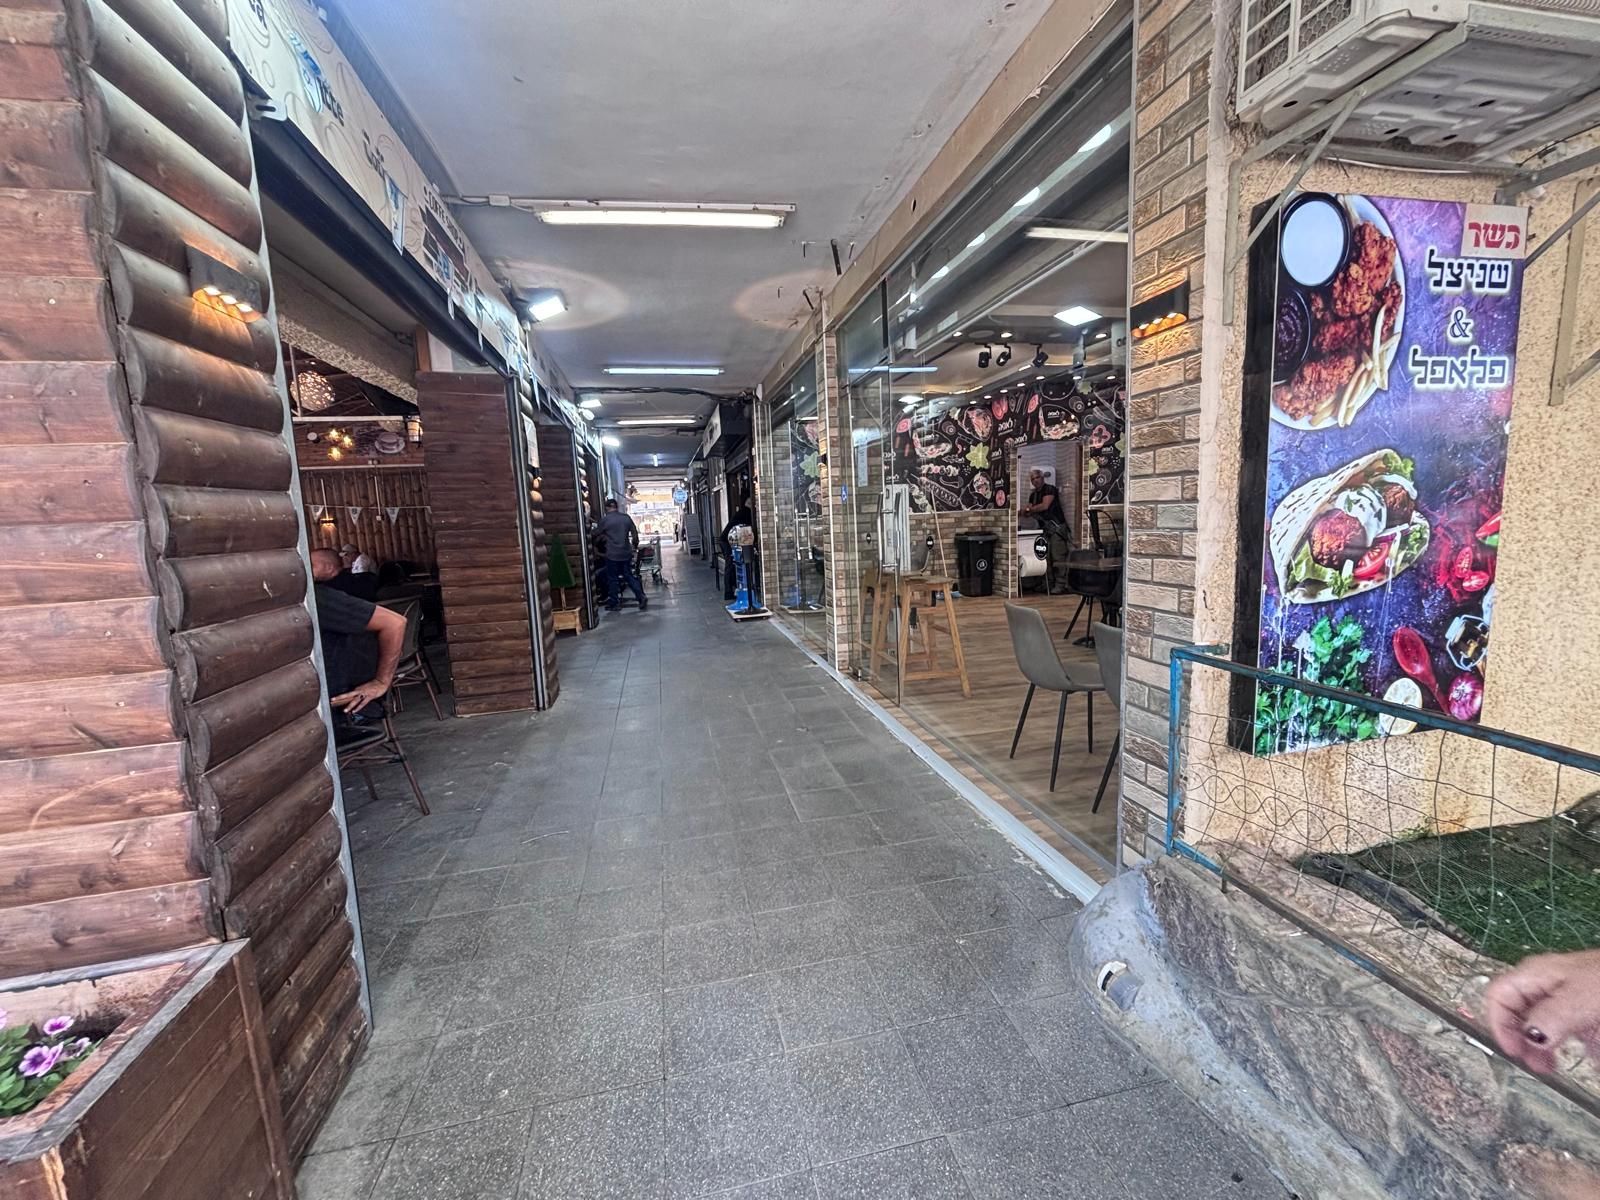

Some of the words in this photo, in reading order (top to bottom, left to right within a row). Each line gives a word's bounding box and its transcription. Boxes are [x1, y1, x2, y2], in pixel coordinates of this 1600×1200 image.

[1468, 222, 1521, 250] כשר
[1427, 248, 1510, 289] שניצל
[1449, 309, 1472, 338] &
[1411, 348, 1507, 385] פלאפל
